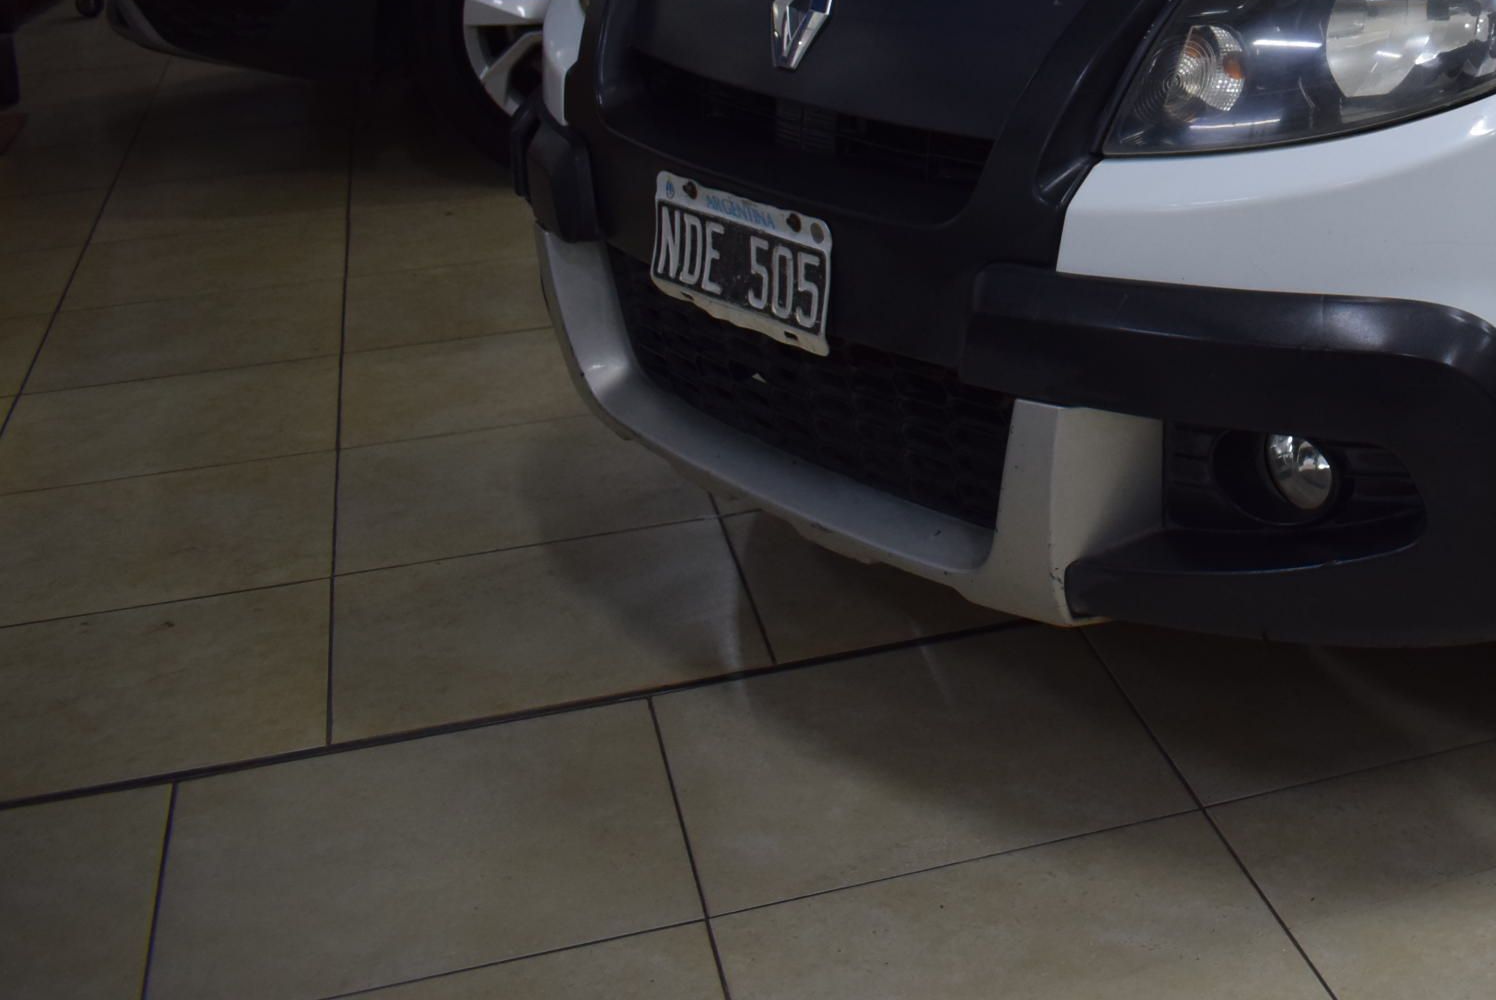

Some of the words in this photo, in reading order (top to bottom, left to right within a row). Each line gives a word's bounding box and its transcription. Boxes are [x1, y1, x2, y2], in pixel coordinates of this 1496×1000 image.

[705, 194, 776, 231] ARGENTINA
[657, 205, 725, 296] NDE
[748, 234, 821, 329] 505
